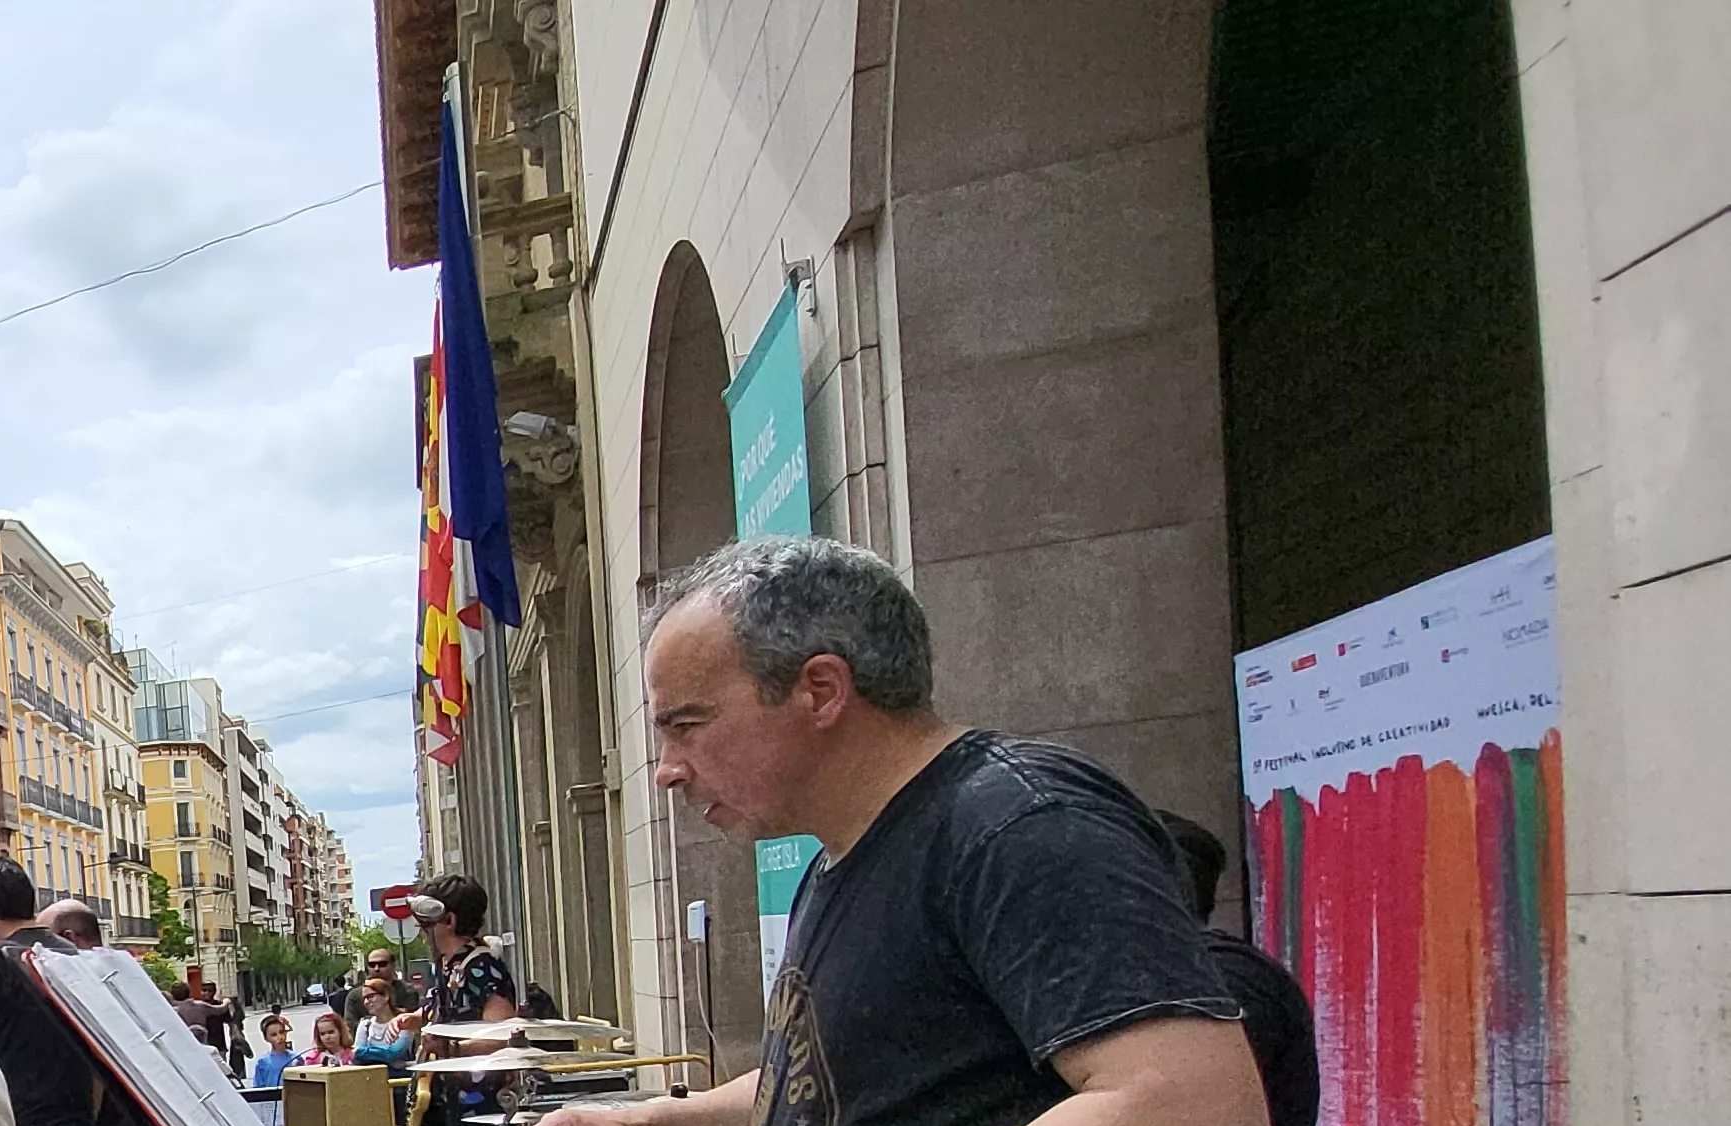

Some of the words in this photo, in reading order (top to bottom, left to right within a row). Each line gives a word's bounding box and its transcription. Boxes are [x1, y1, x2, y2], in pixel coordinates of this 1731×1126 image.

[1264, 751, 1307, 771] FESTIVAL
[1361, 734, 1373, 748] DE
[1378, 716, 1451, 744] CREATIVIDAD
